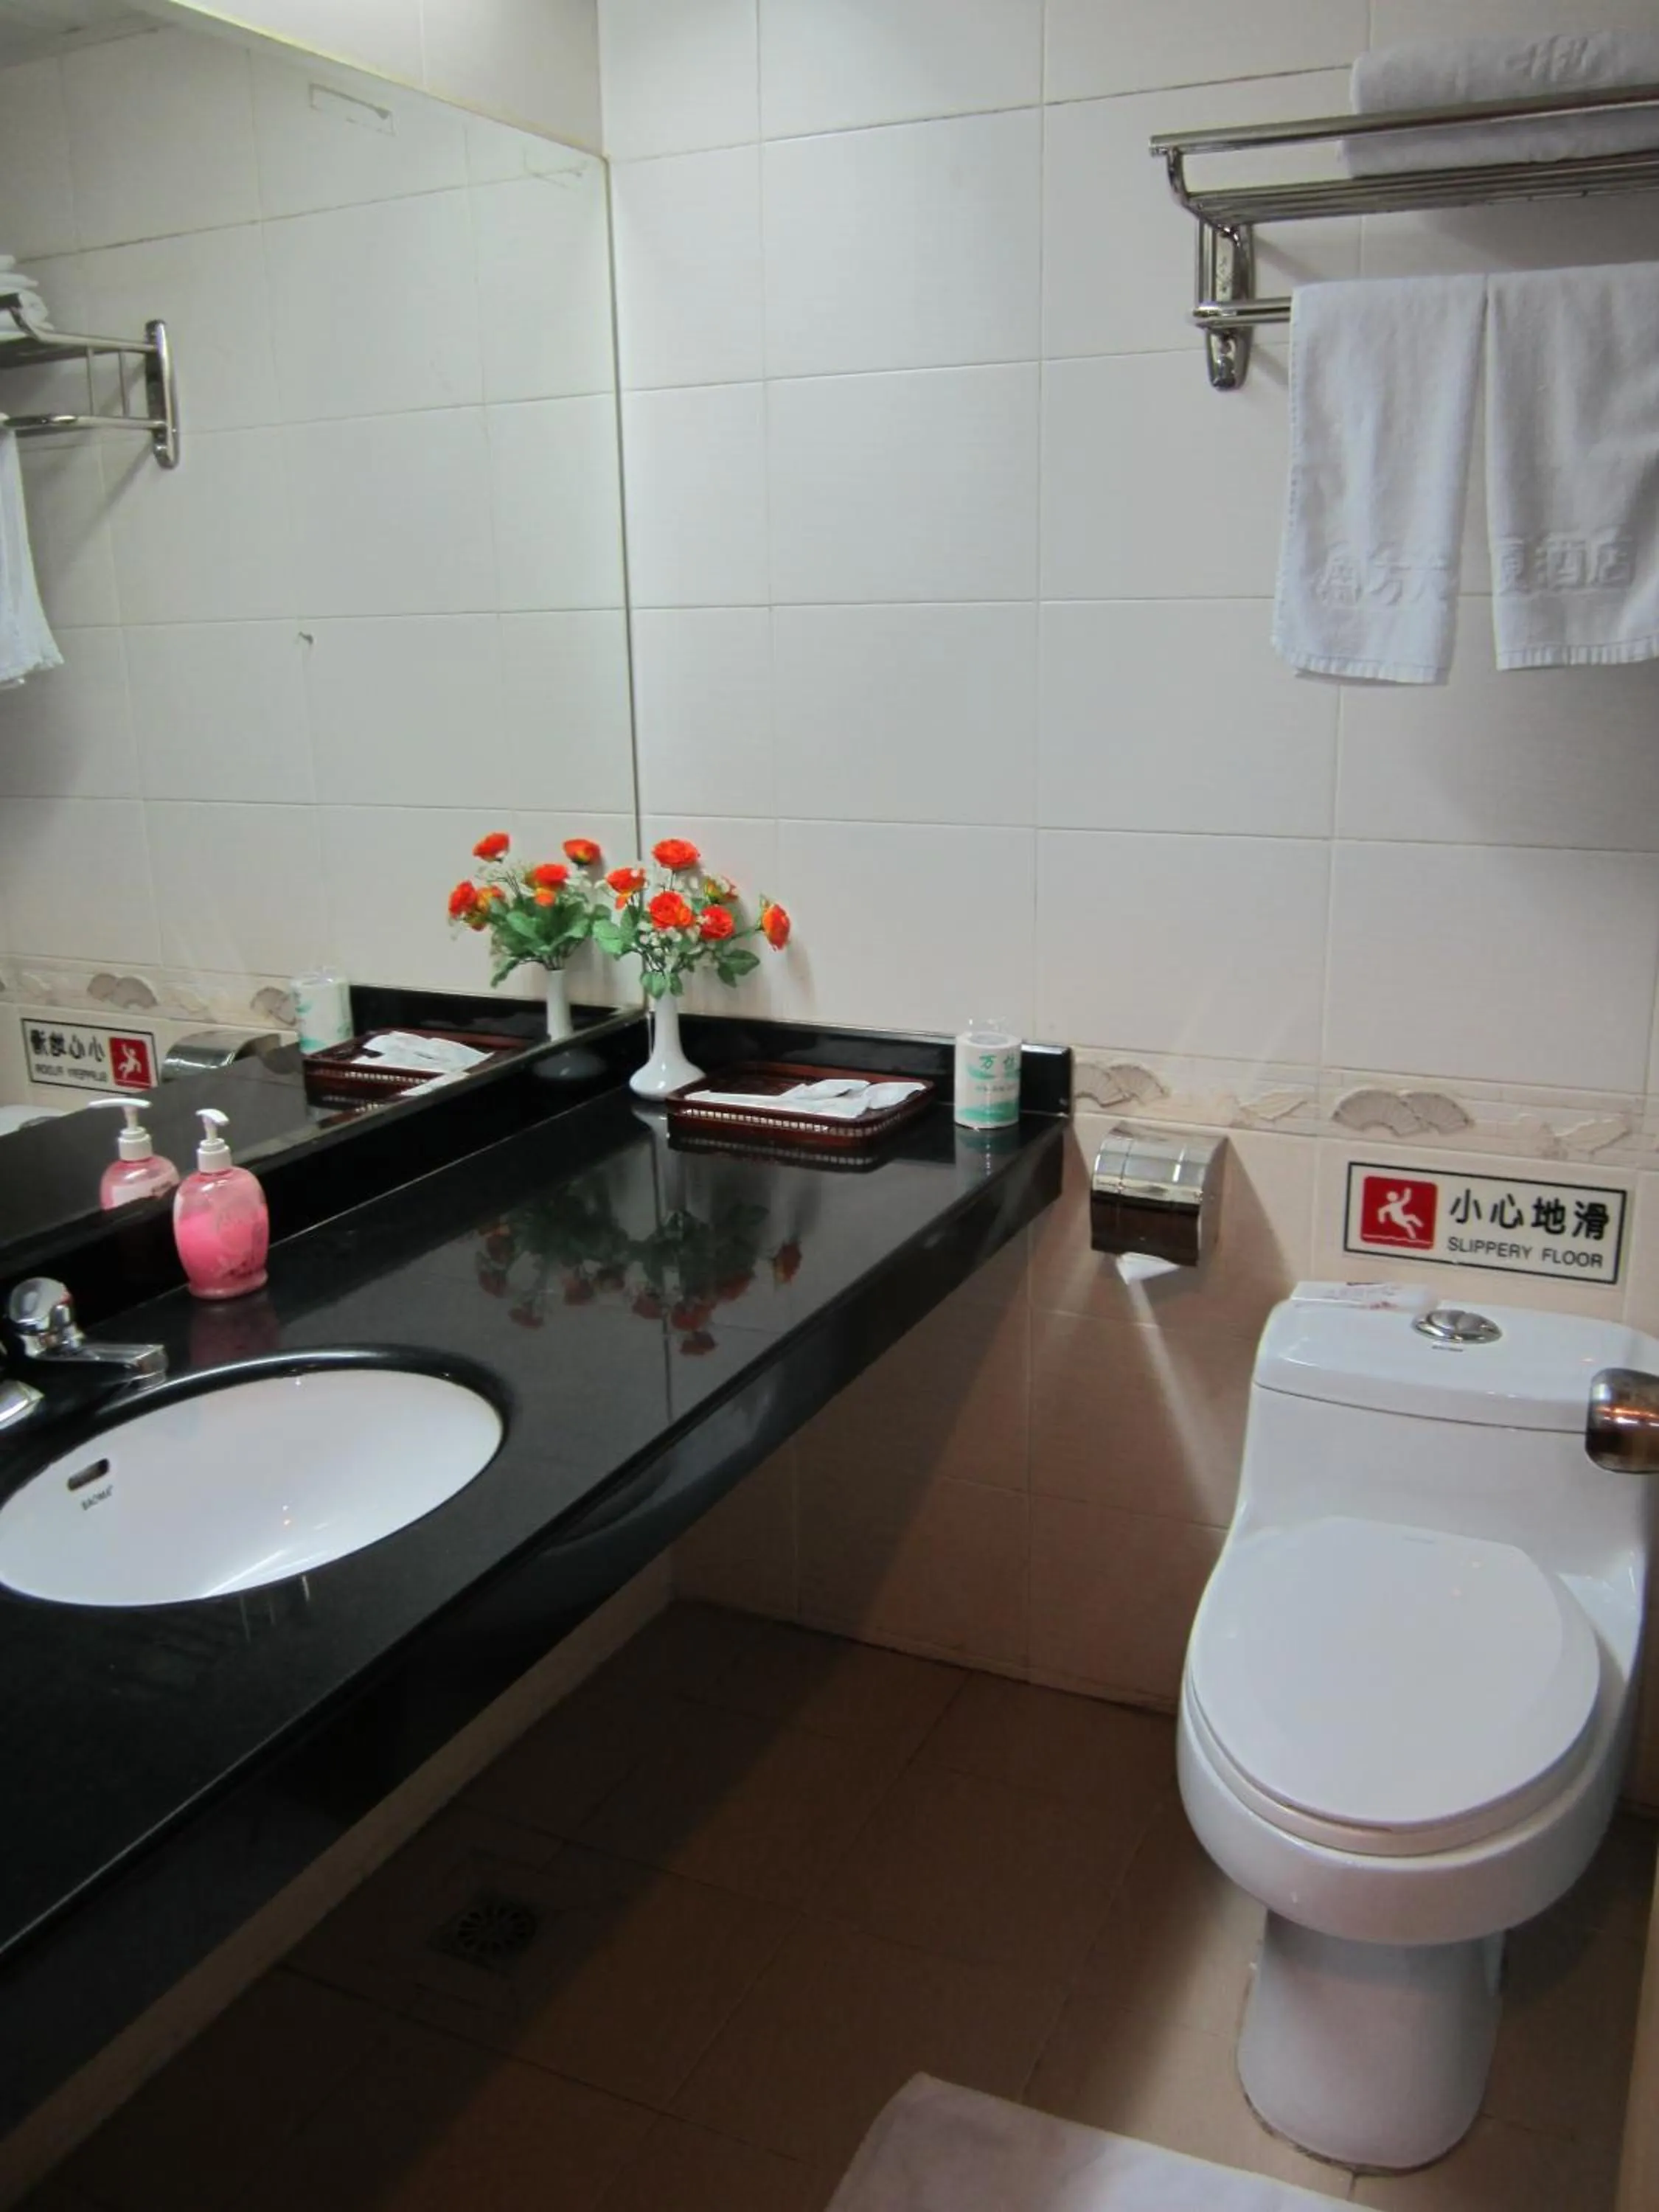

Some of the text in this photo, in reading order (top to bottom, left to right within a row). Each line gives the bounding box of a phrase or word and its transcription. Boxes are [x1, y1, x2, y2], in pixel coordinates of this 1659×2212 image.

[1450, 1188, 1609, 1241] 小心地滑
[1447, 1236, 1604, 1268] SLIPPERY FLOOR
